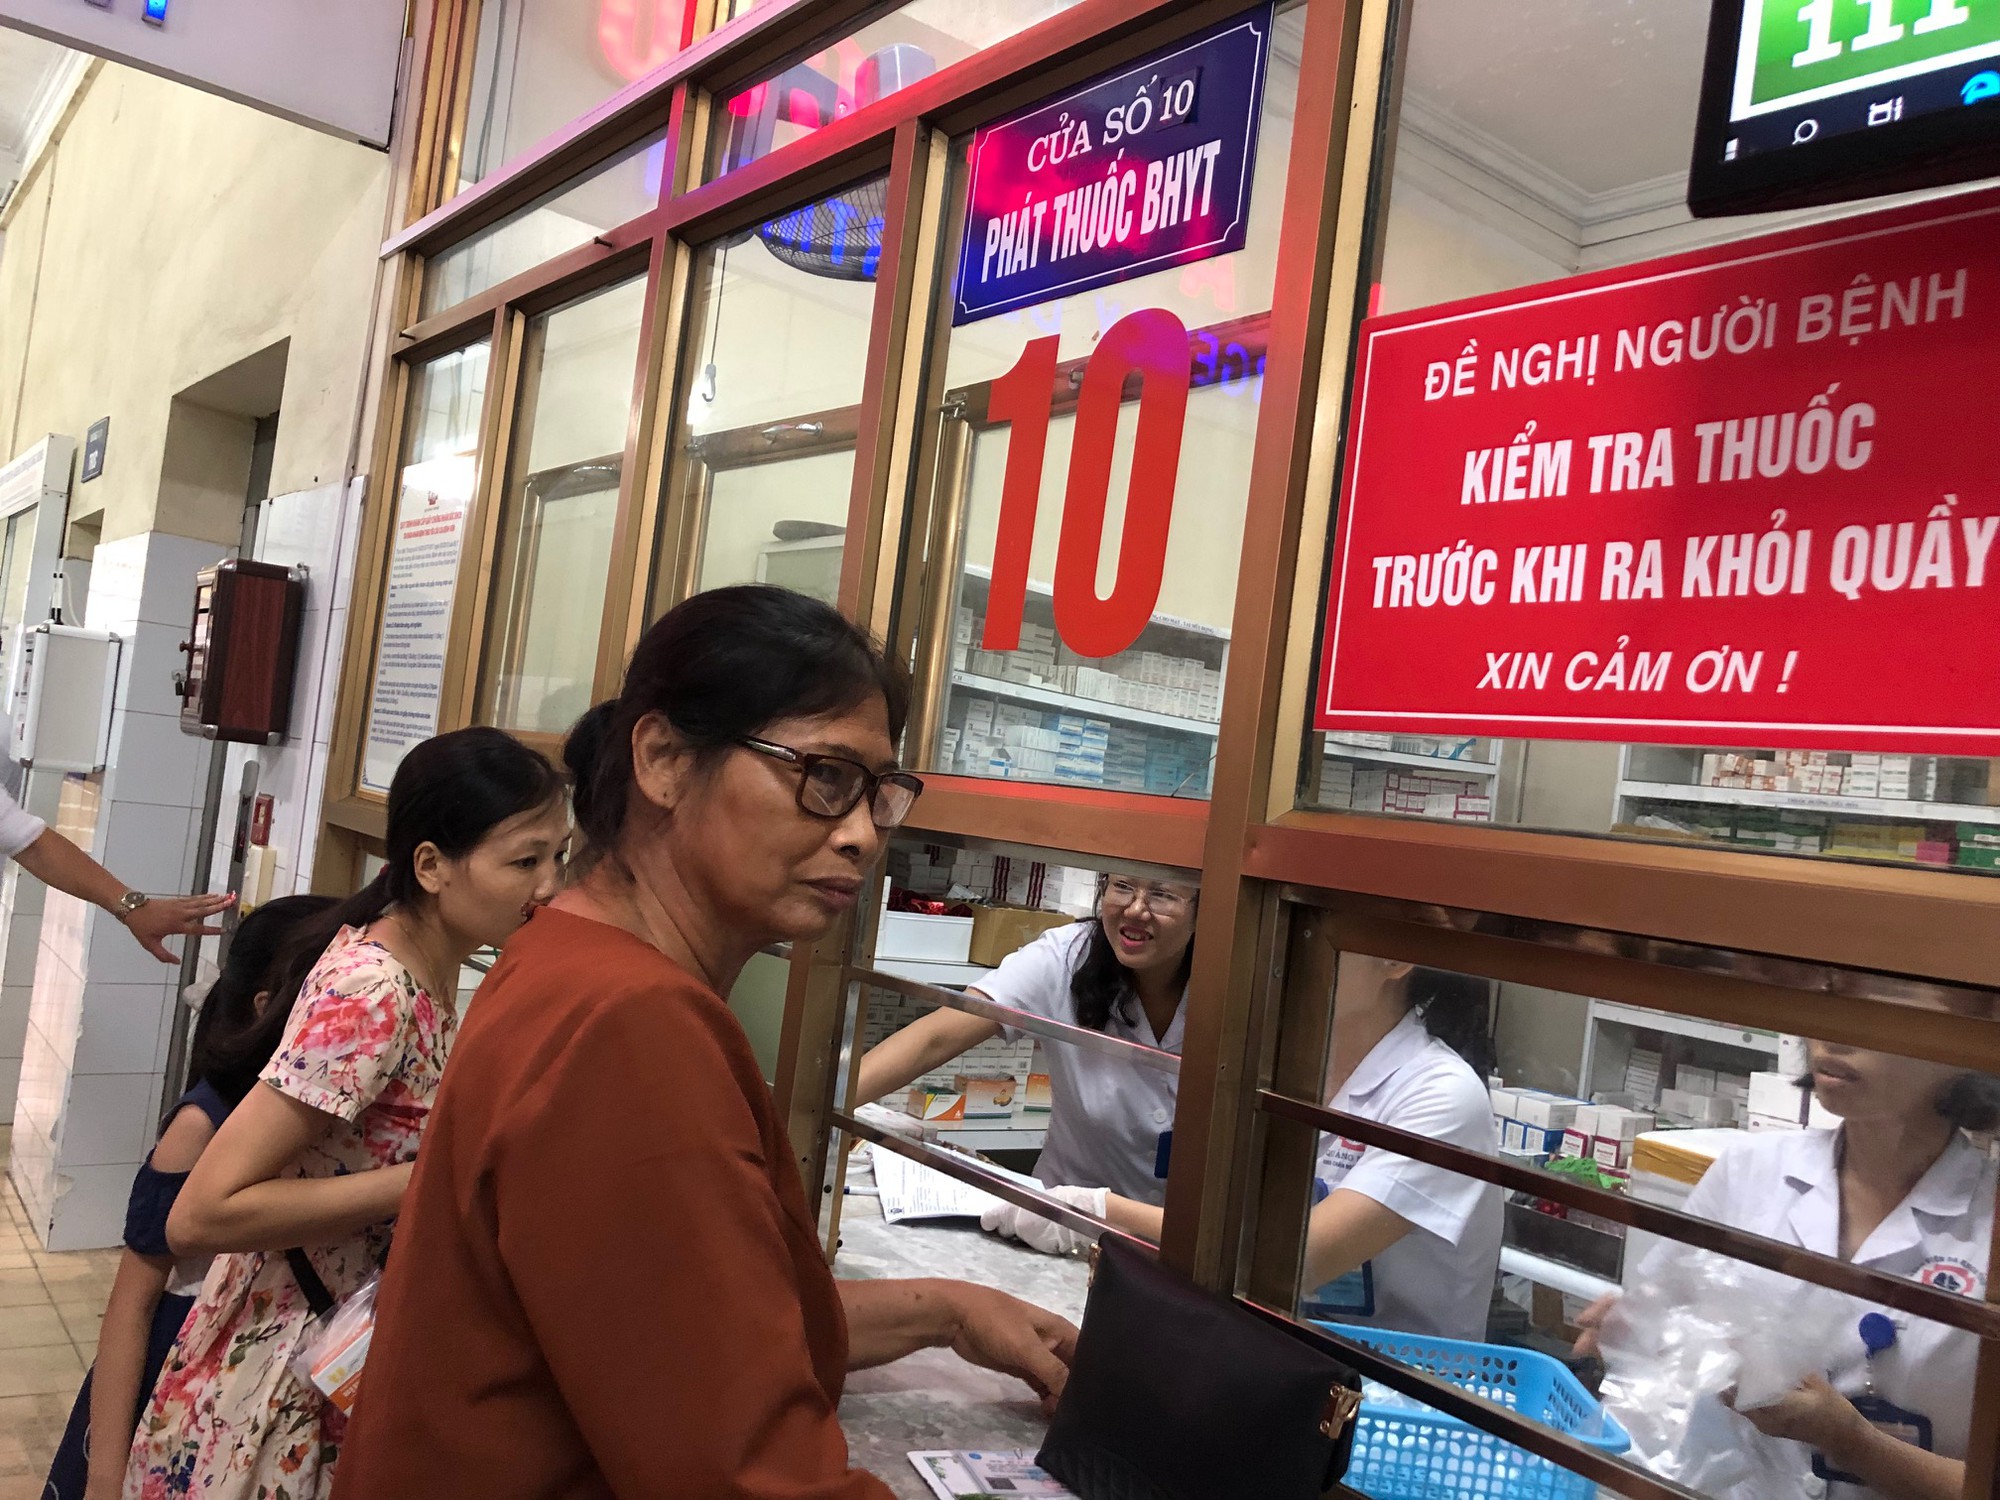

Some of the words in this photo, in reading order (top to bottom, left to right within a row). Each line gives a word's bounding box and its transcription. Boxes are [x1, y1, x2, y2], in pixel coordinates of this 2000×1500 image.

[1027, 112, 1092, 172] CỬA
[1102, 74, 1157, 145] SỐ
[1159, 79, 1194, 122] 10
[981, 192, 1047, 283] PHÁT
[1050, 147, 1137, 262] THUỐC
[1140, 139, 1221, 235] BHYT
[1424, 338, 1478, 401] ĐỀ
[1491, 334, 1599, 391] NGHỊ
[1614, 295, 1777, 373] NGƯỜI
[1796, 268, 1967, 346] BỆNH
[981, 307, 1191, 659] 10
[1460, 420, 1573, 505] KIỂM
[1587, 427, 1674, 494] TRA
[1694, 382, 1875, 484] THUỐC
[1372, 539, 1499, 608] TRƯỚC
[1509, 543, 1587, 604] KHI
[1599, 538, 1664, 601] RA
[1681, 508, 1813, 598] KHỎI
[1829, 494, 2000, 600] QUẦY
[1476, 652, 1553, 689] XIN
[1564, 634, 1673, 691] CẢM
[1685, 645, 1764, 693] ƠN
[1776, 650, 1800, 693] !
